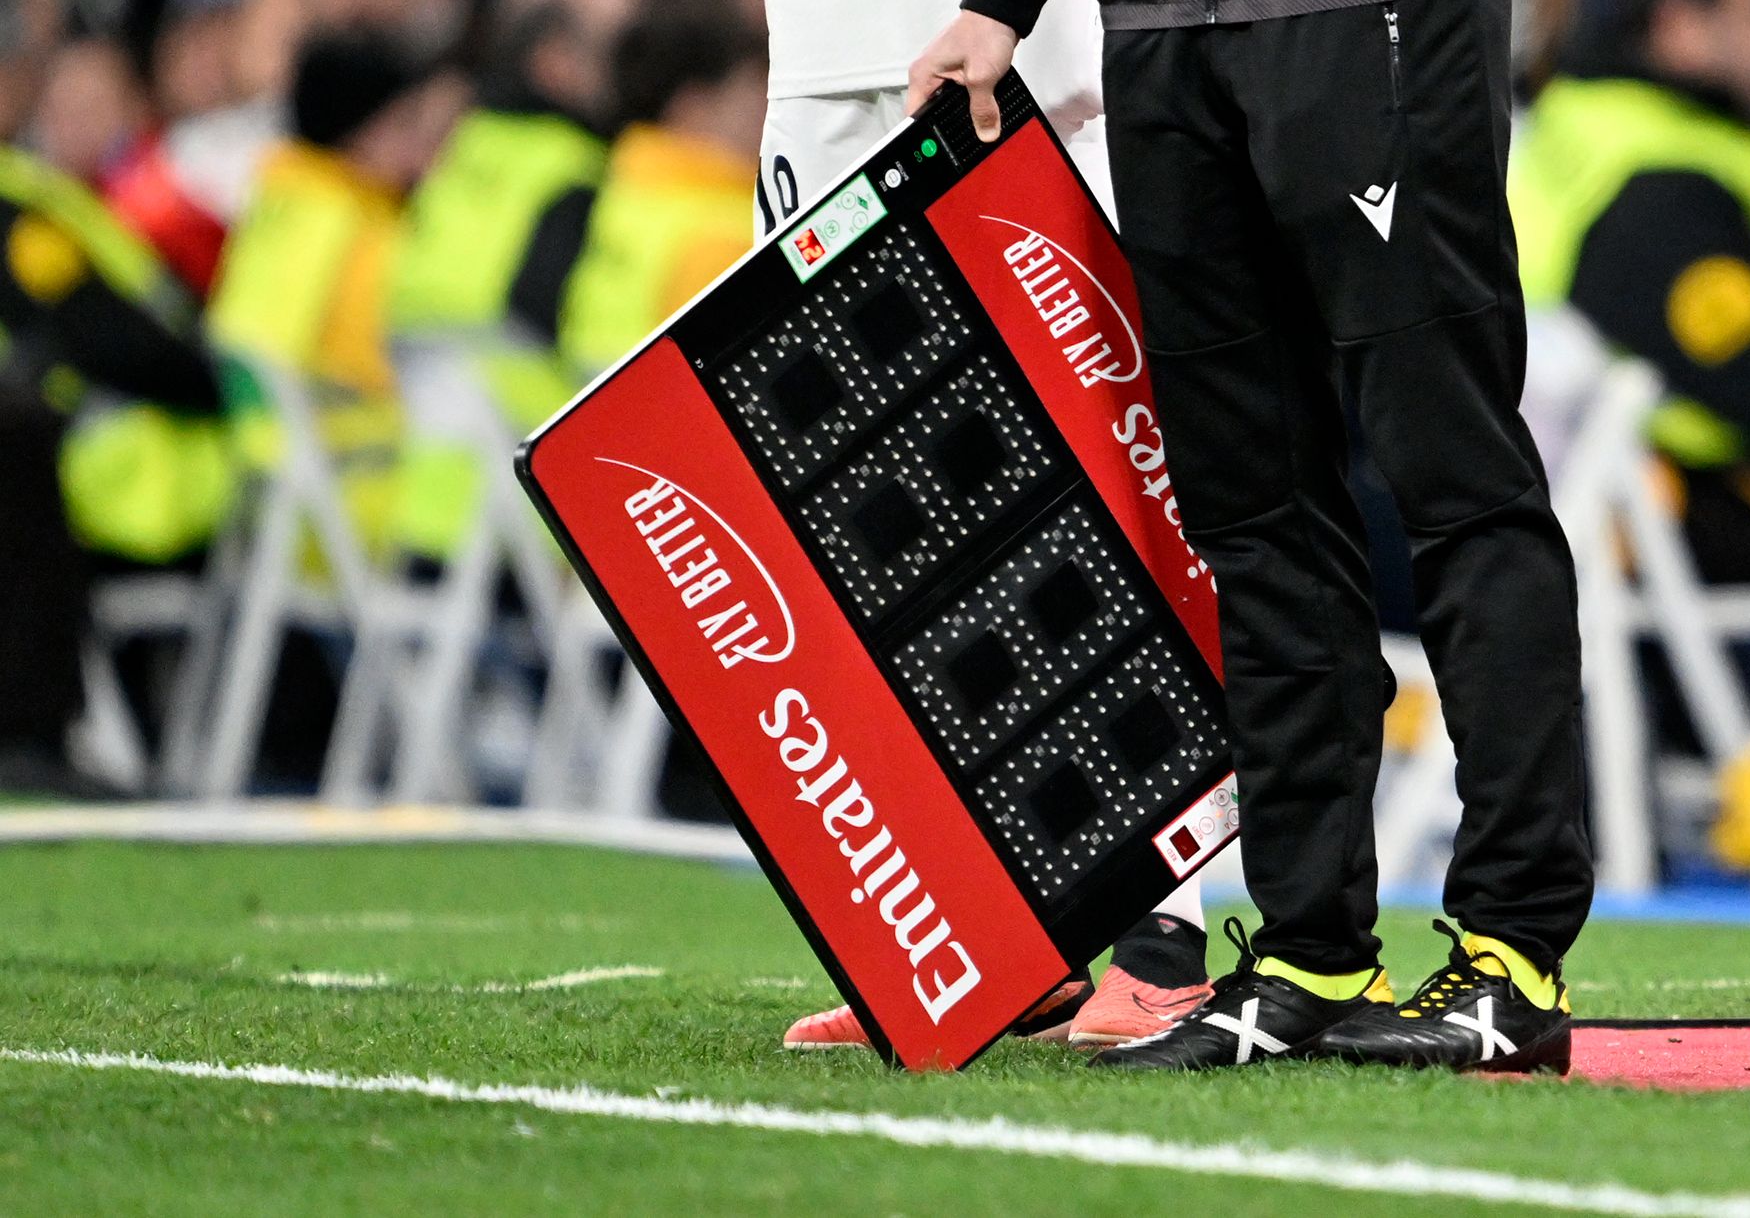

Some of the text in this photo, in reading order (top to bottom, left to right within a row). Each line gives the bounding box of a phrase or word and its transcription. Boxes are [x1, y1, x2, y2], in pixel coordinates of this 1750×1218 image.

[1003, 231, 1121, 389] FLY BETTER
[623, 478, 770, 670] FLY BETTER
[758, 687, 982, 1027] Emirates
